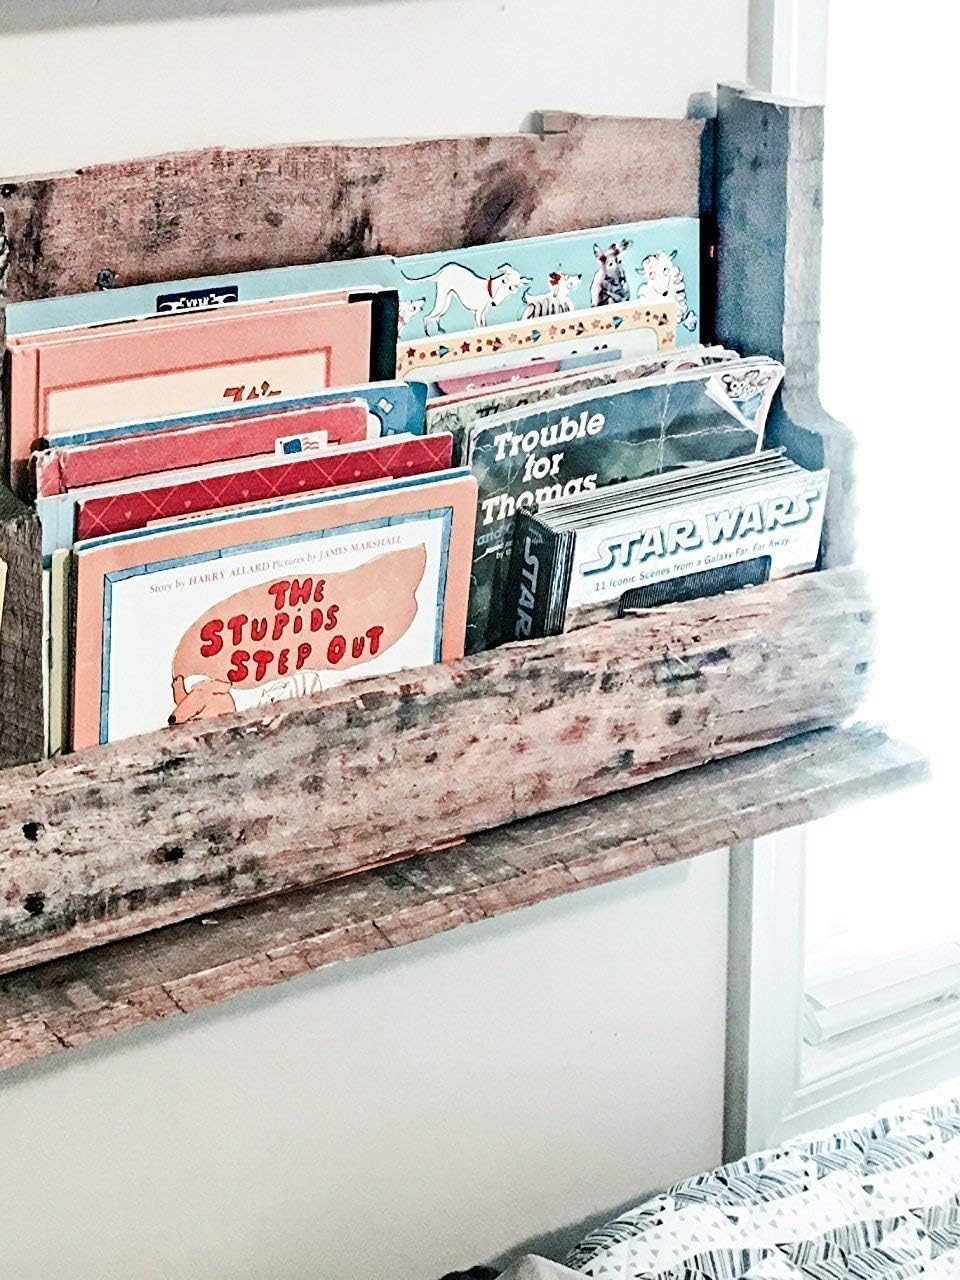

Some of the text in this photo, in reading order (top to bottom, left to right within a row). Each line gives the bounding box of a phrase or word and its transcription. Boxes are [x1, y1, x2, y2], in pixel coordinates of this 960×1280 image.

[494, 411, 606, 461] Trouble
[522, 452, 565, 483] for
[481, 473, 598, 526] Thomas
[476, 527, 505, 546] and
[579, 487, 821, 576] STAR WARS
[149, 536, 403, 595] Story by HARRY ALLARD Pictures by JAMES MARSHALL
[514, 536, 539, 639] STAR
[594, 582, 606, 592] 11
[609, 575, 636, 588] Iconic
[639, 566, 670, 581] Scenes
[673, 561, 694, 574] from
[704, 551, 733, 565] Galaxy
[735, 545, 751, 557] Far,
[267, 577, 326, 611] THE
[227, 625, 385, 684] STEP OUT
